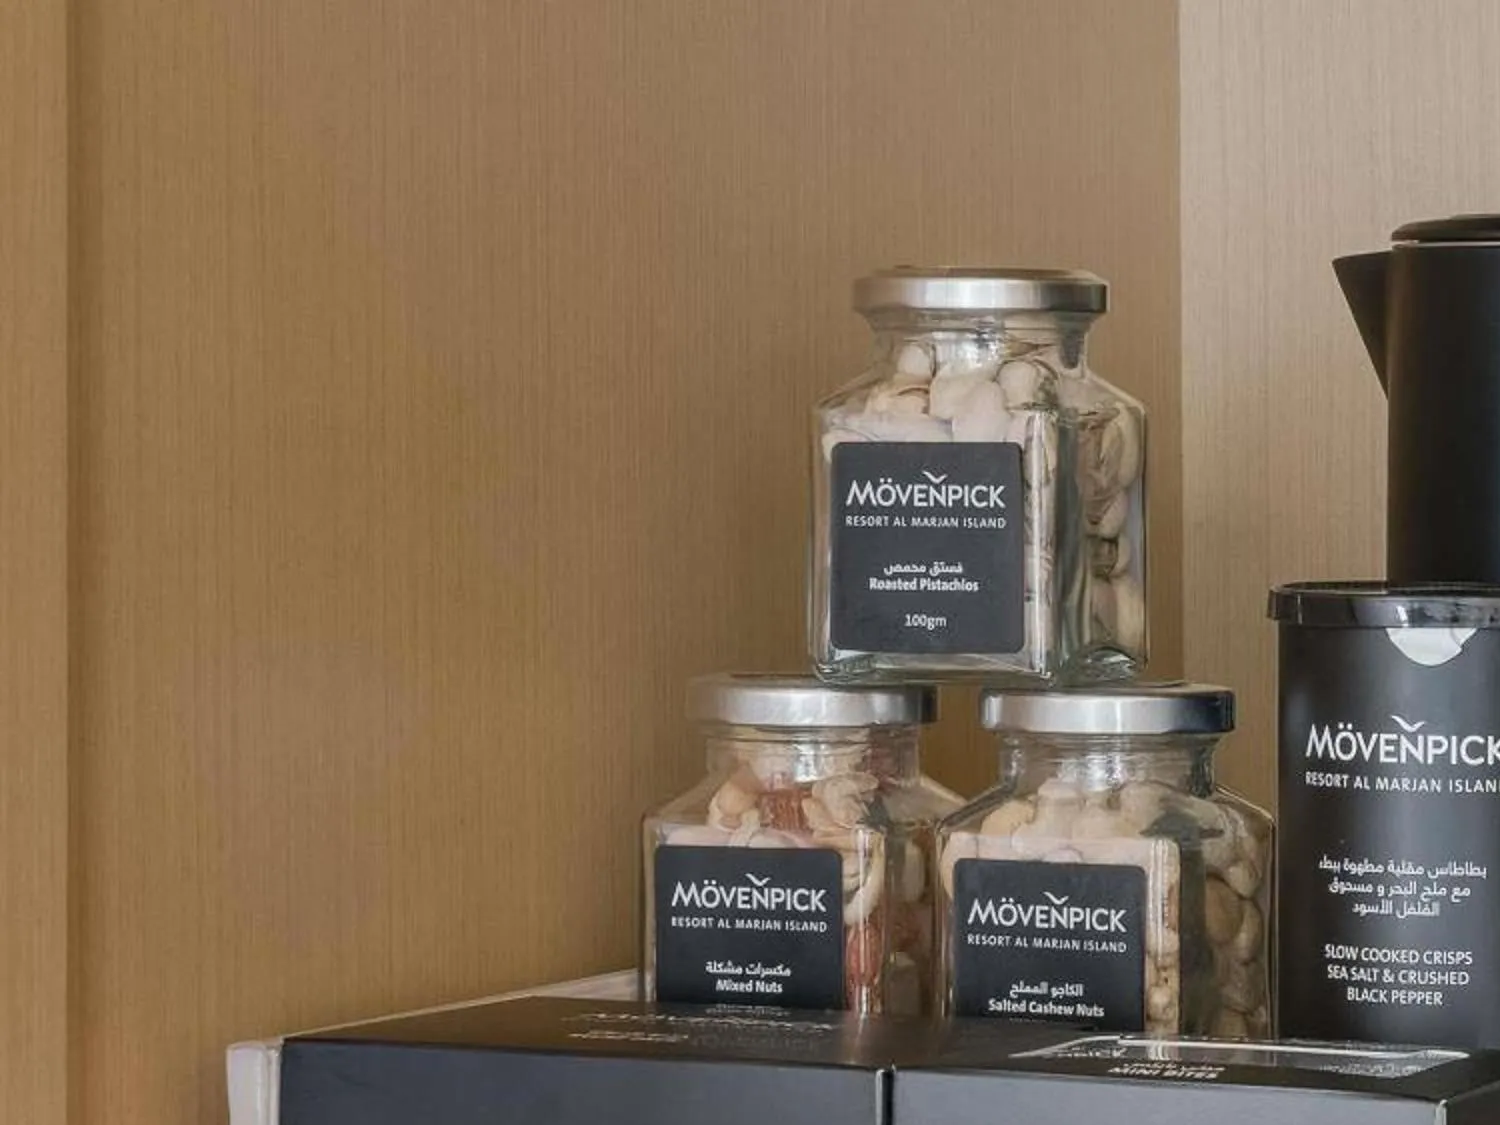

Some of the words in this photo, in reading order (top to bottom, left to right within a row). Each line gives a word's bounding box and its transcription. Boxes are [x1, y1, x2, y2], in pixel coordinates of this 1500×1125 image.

[846, 478, 1006, 508] MÖVENPICK
[846, 515, 889, 527] RESORT
[893, 516, 907, 527] AL
[911, 516, 959, 528] MARJAN
[963, 517, 1006, 529] ISLAND
[884, 561, 926, 576] محمض
[929, 561, 963, 576] فستق
[869, 578, 917, 591] Roasted
[920, 578, 979, 592] Pistachios
[904, 614, 947, 630] 100gm
[1305, 771, 1349, 788] RESORT
[1354, 776, 1370, 790] AL
[1376, 777, 1442, 793] MARJAN
[1328, 876, 1374, 896] مسحوق
[1388, 881, 1417, 898] البحر
[1420, 882, 1448, 902] ملح
[1451, 886, 1471, 902] مع
[672, 880, 826, 912] MÖVENPICK
[967, 897, 1127, 933] MÖVENPICK
[672, 916, 714, 928] RESORT
[718, 917, 731, 929] AL
[736, 918, 781, 931] MARJAN
[786, 920, 828, 933] ISLAND
[967, 934, 1012, 947] RESORT
[1014, 936, 1028, 948] AL
[1032, 937, 1080, 950] MARJAN
[1083, 940, 1127, 953] ISLAND
[1324, 944, 1358, 961] SLOW
[1360, 947, 1419, 964] COOKED
[1423, 950, 1474, 966] CRISPS
[706, 960, 743, 975] مشكلة
[745, 962, 791, 978] مكسرات
[1327, 965, 1348, 980] SEA
[1351, 966, 1380, 982] SALT
[1383, 970, 1395, 983] &
[1398, 970, 1470, 986] CRUSHED
[716, 979, 753, 993] Mixed
[756, 980, 783, 994] Nuts
[1050, 983, 1084, 998] الكاجو
[1346, 987, 1388, 1004] BLACK
[1391, 990, 1444, 1006] PEPPER
[988, 998, 1026, 1013] Salted
[1028, 1000, 1074, 1015] Cashew
[1076, 1004, 1105, 1018] Nuts
[1108, 1067, 1160, 1076] MINI
